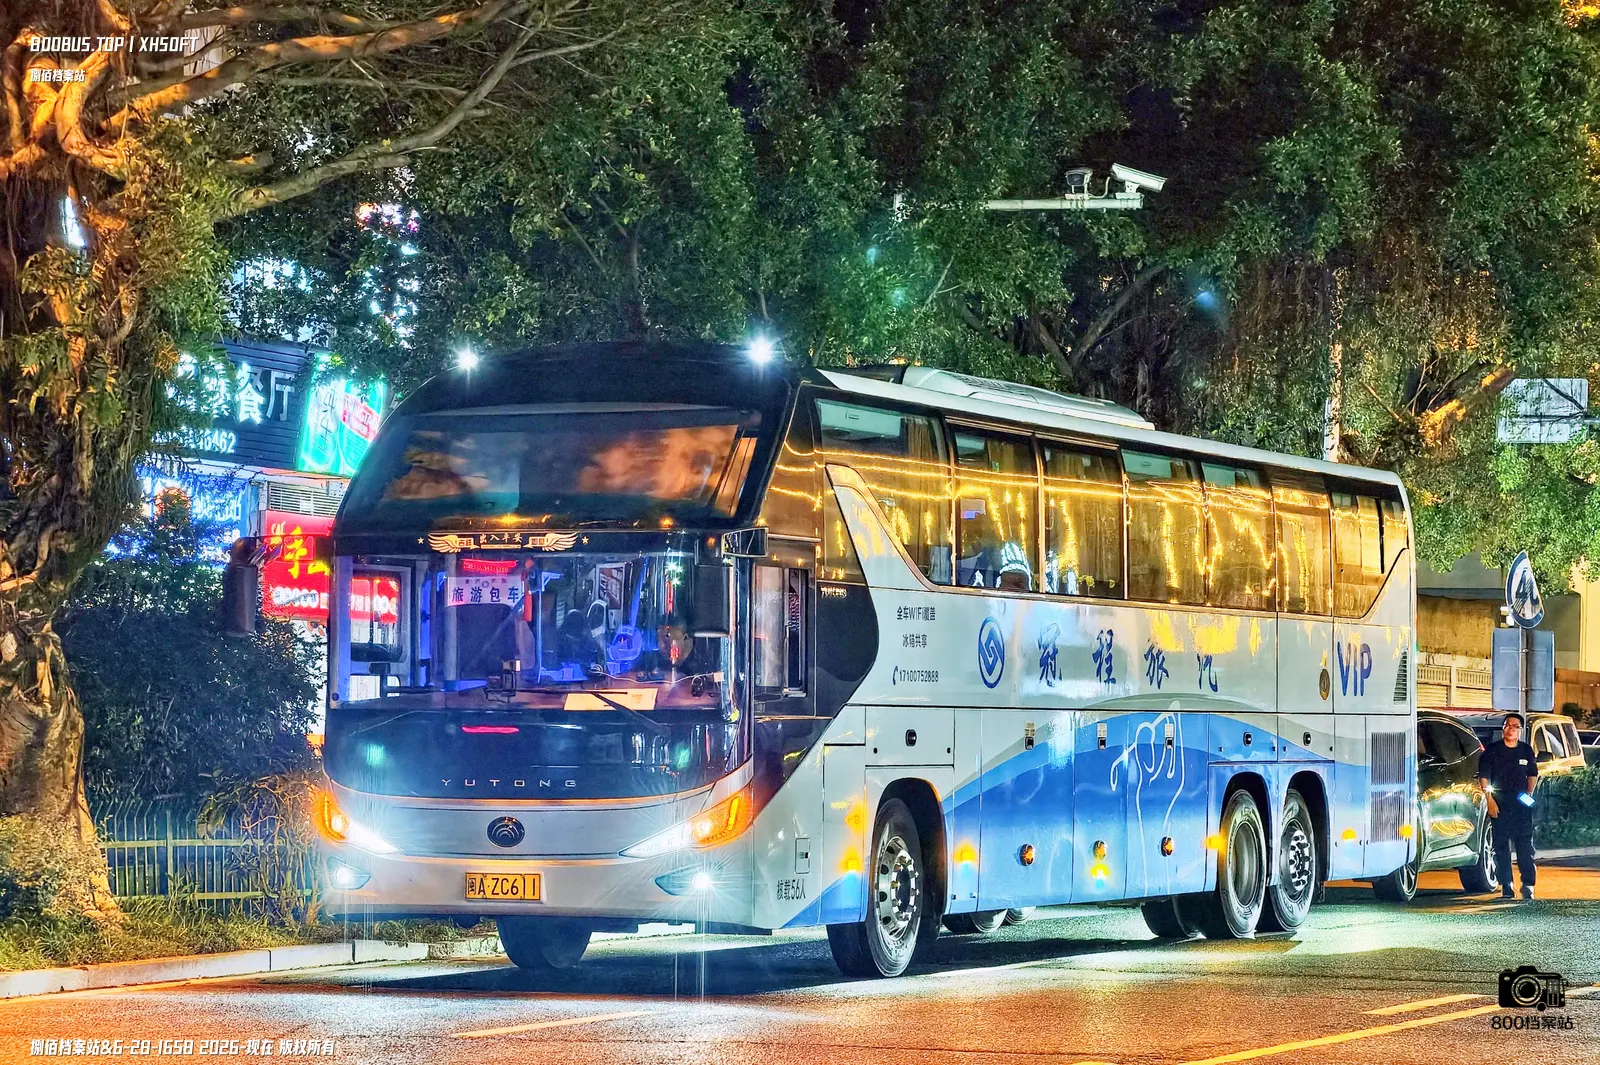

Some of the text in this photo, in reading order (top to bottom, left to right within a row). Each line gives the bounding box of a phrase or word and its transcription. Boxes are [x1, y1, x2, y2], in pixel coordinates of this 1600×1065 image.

[479, 532, 523, 544] 出入平安
[452, 586, 520, 603] 旅游包车
[902, 633, 928, 648] 冰箱共享
[1336, 641, 1372, 697] VIP
[441, 779, 577, 788] YUTONG
